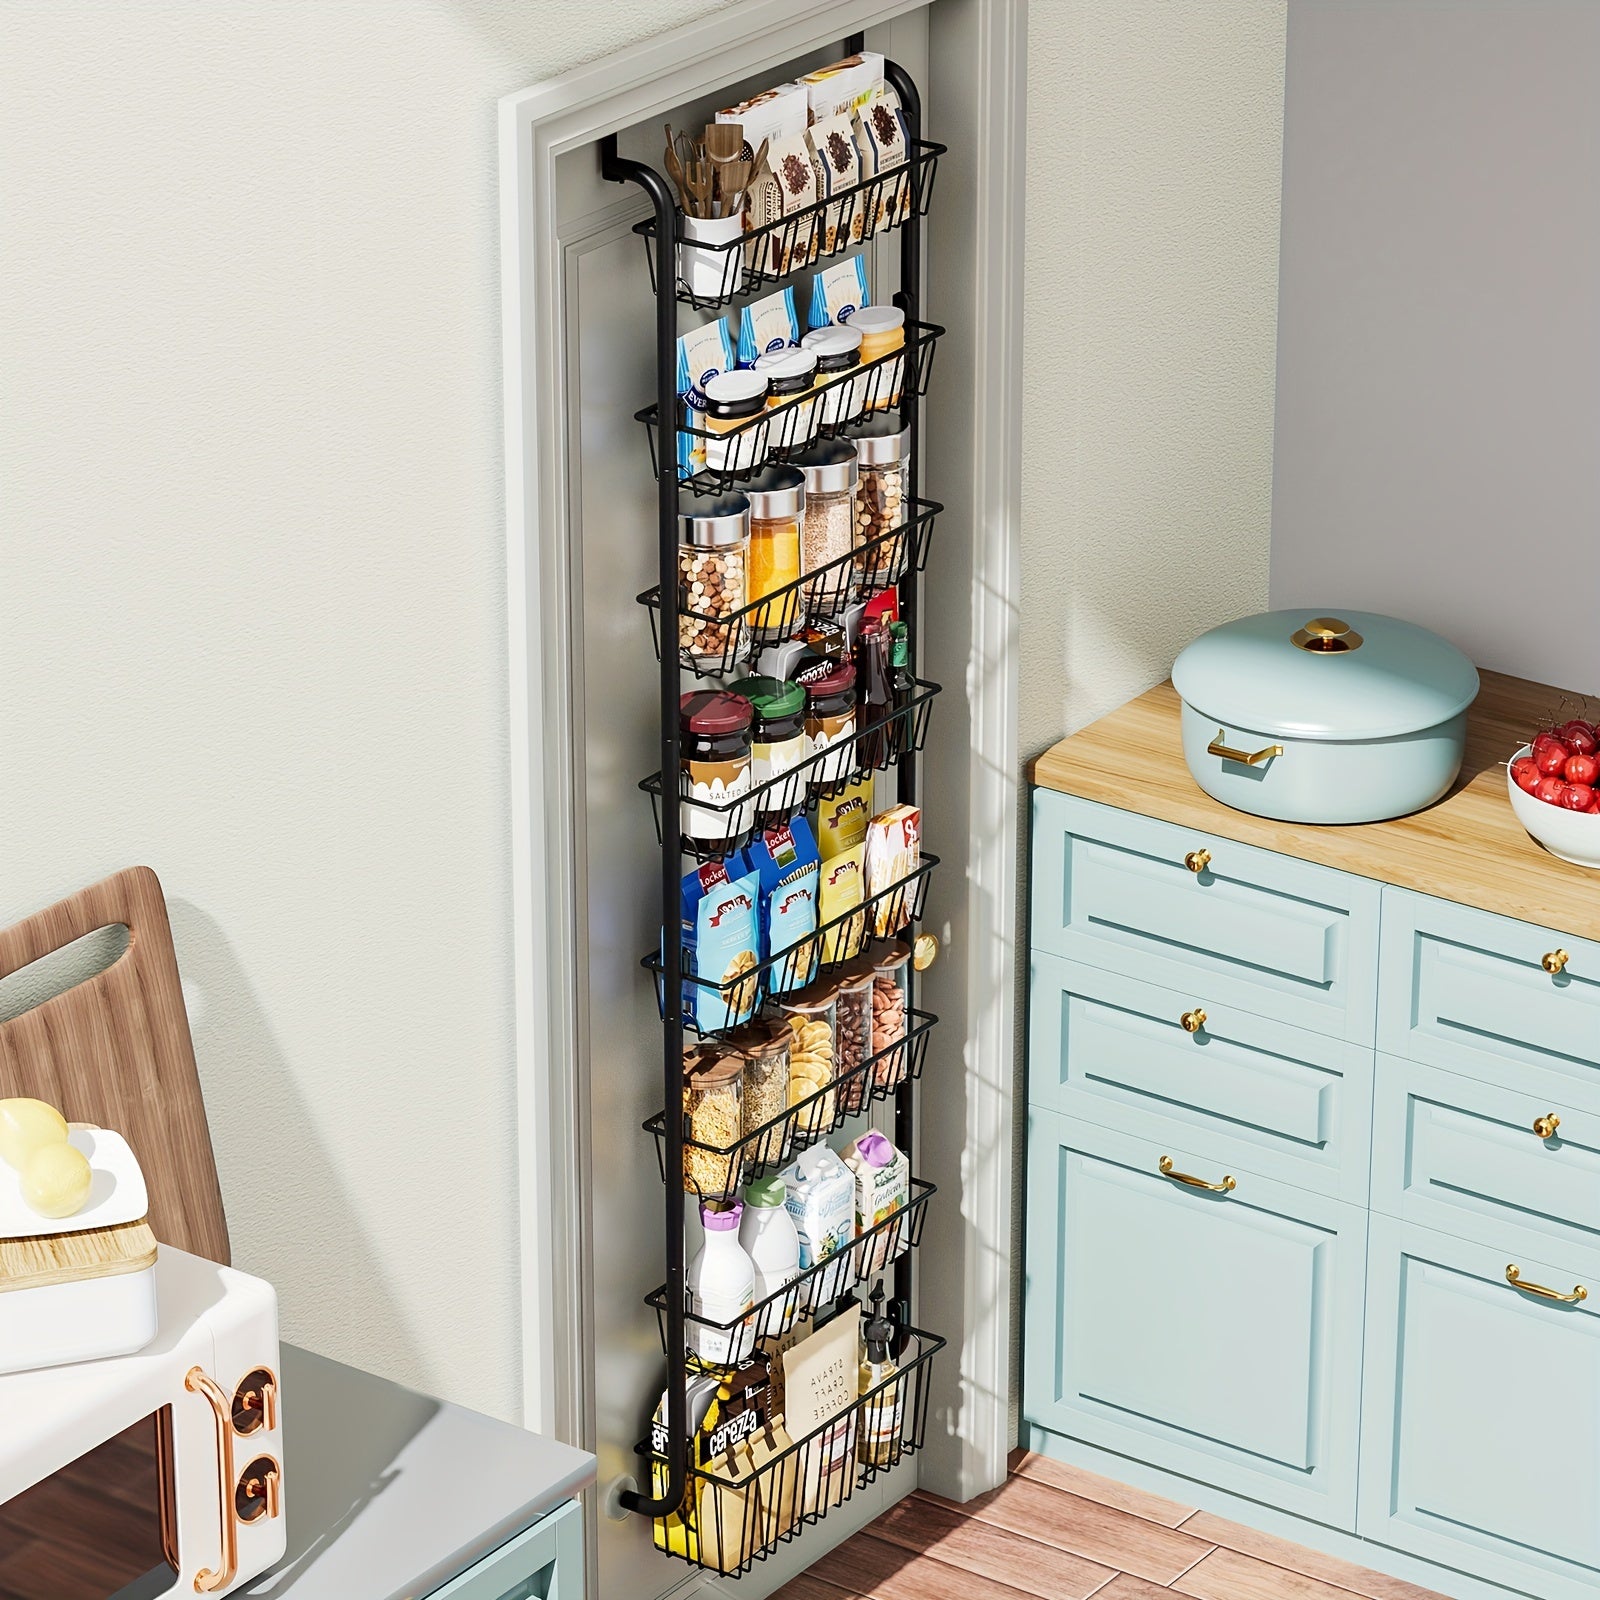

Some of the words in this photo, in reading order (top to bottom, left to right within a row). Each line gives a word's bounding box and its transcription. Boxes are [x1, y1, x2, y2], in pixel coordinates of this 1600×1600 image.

[786, 203, 801, 214] MILK
[688, 390, 707, 408] EVER
[709, 788, 740, 800] SALTED
[766, 830, 791, 849] Locker
[700, 868, 726, 887] Locker
[709, 1409, 757, 1456] cerezza
